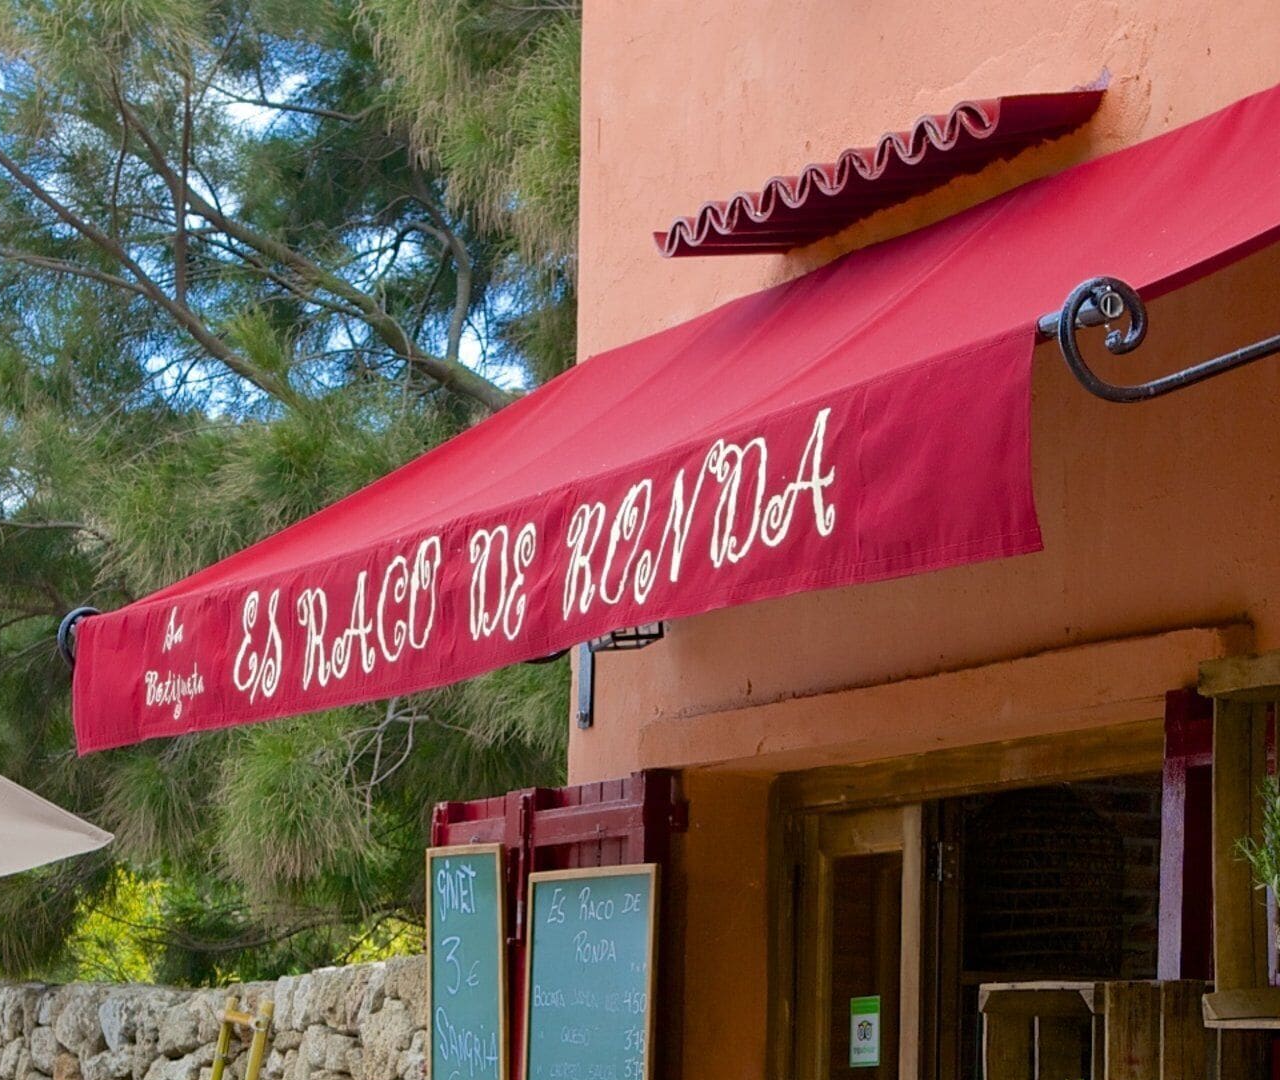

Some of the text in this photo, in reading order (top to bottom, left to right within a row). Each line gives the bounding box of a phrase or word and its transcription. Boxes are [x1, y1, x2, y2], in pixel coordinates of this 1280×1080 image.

[233, 408, 835, 705] ES RACO DE RONDA
[621, 892, 641, 914] DE
[441, 936, 481, 994] 3 €
